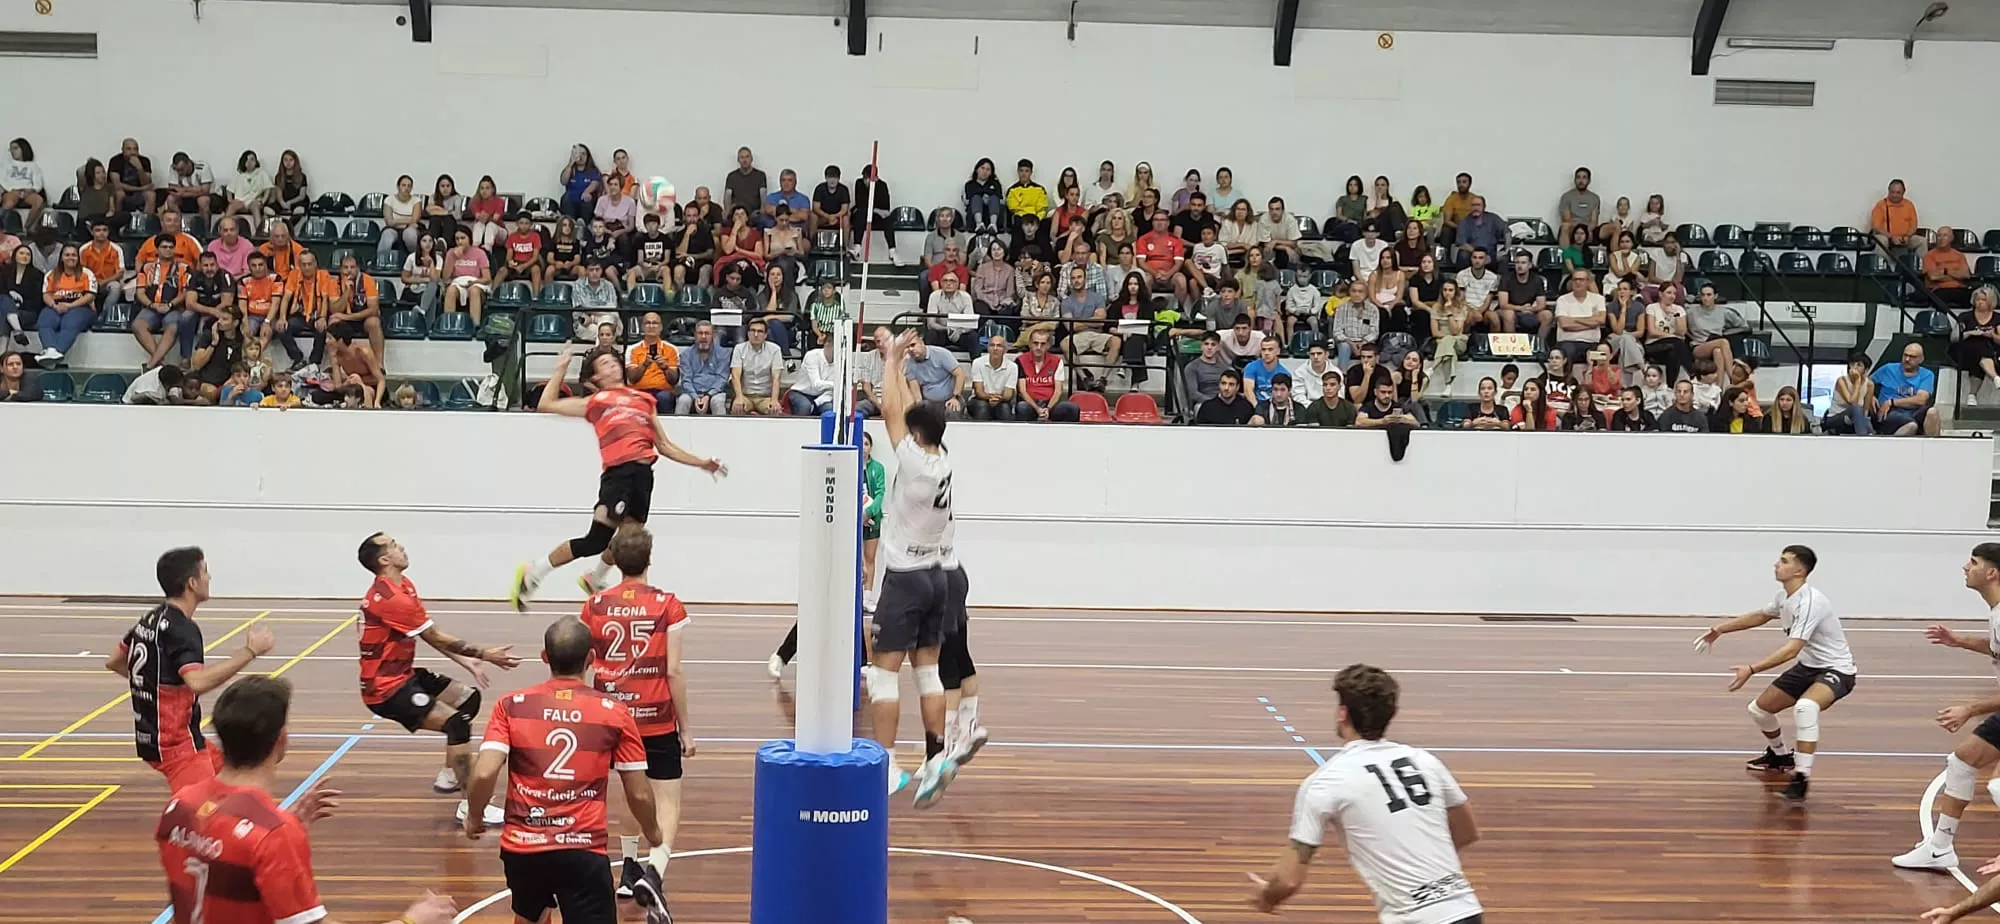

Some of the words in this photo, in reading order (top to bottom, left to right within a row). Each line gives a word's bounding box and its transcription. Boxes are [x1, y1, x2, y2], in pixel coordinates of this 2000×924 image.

[825, 477, 835, 523] MONDO
[607, 606, 647, 616] LEONA
[602, 620, 655, 661] 25
[543, 708, 582, 723] FALO
[543, 727, 578, 780] 2
[1364, 757, 1431, 813] 16
[813, 809, 869, 823] MONDO
